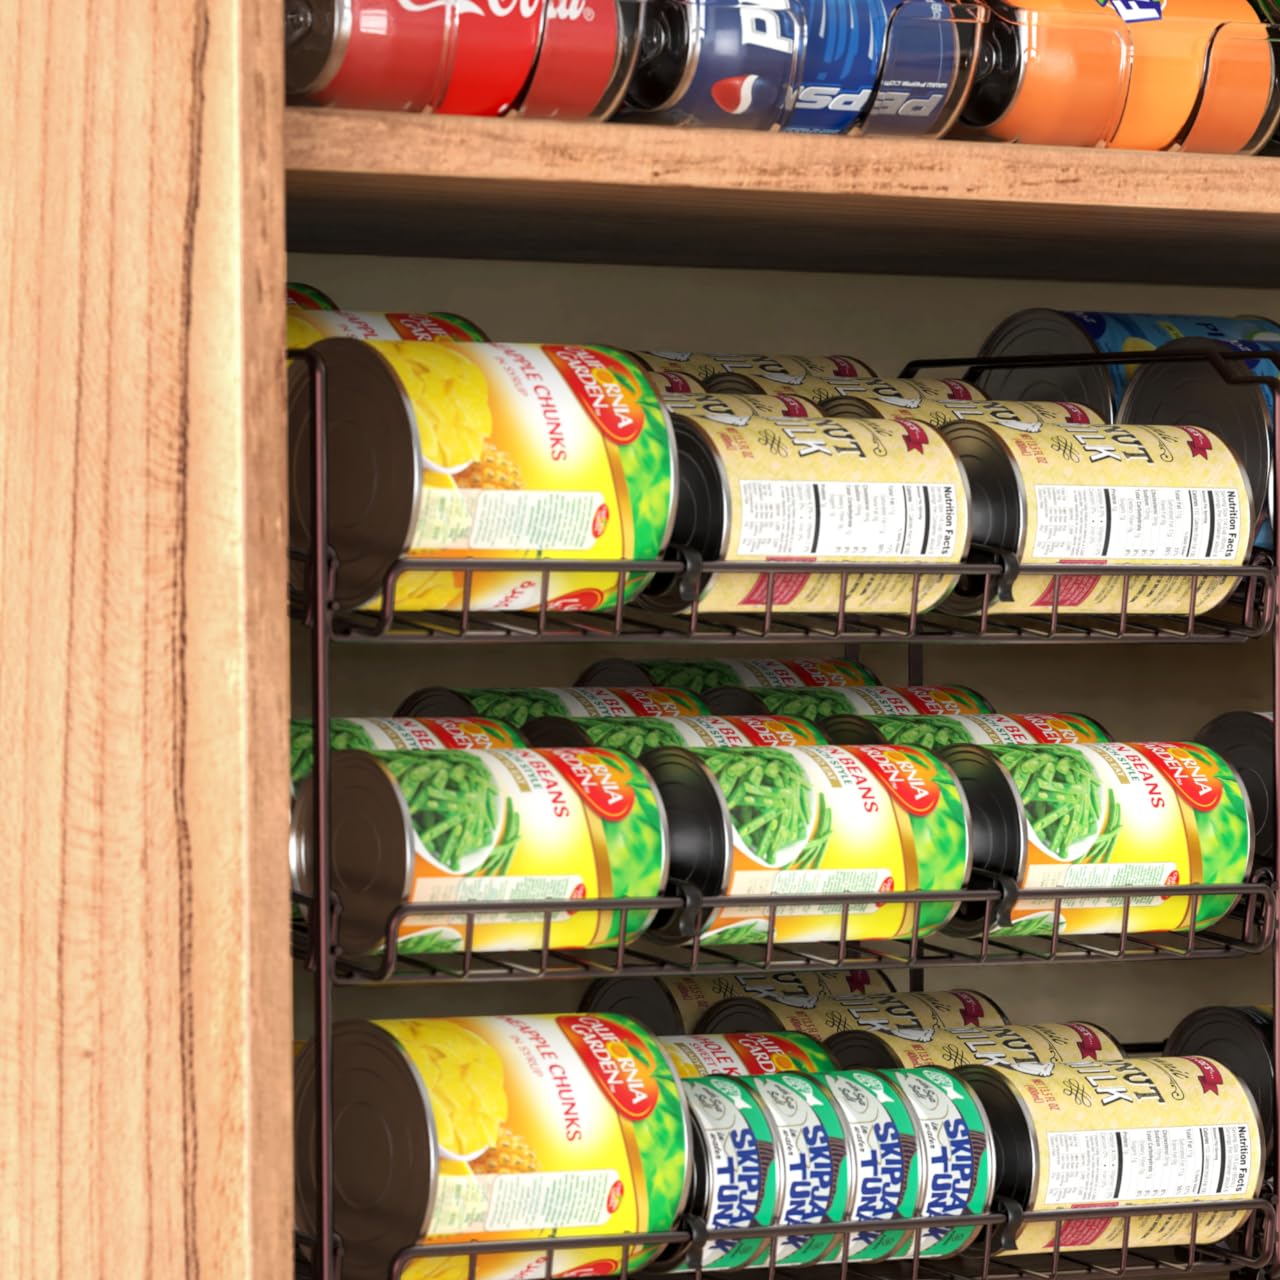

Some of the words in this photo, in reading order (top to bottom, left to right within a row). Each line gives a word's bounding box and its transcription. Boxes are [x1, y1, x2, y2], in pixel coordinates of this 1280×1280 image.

[533, 385, 567, 461] CHUNKS
[944, 486, 953, 526] Nutrition
[1227, 491, 1236, 530] Nutrition
[942, 530, 953, 554] Facts
[1225, 533, 1236, 557] Facts
[529, 761, 570, 817] BEANS
[838, 758, 878, 812] BEANS
[1126, 755, 1165, 808] BEANS
[571, 1024, 623, 1085] GARDEN
[549, 1064, 582, 1142] CHUNKS
[1237, 1126, 1246, 1165] Nutrition
[1235, 1166, 1248, 1192] Facts
